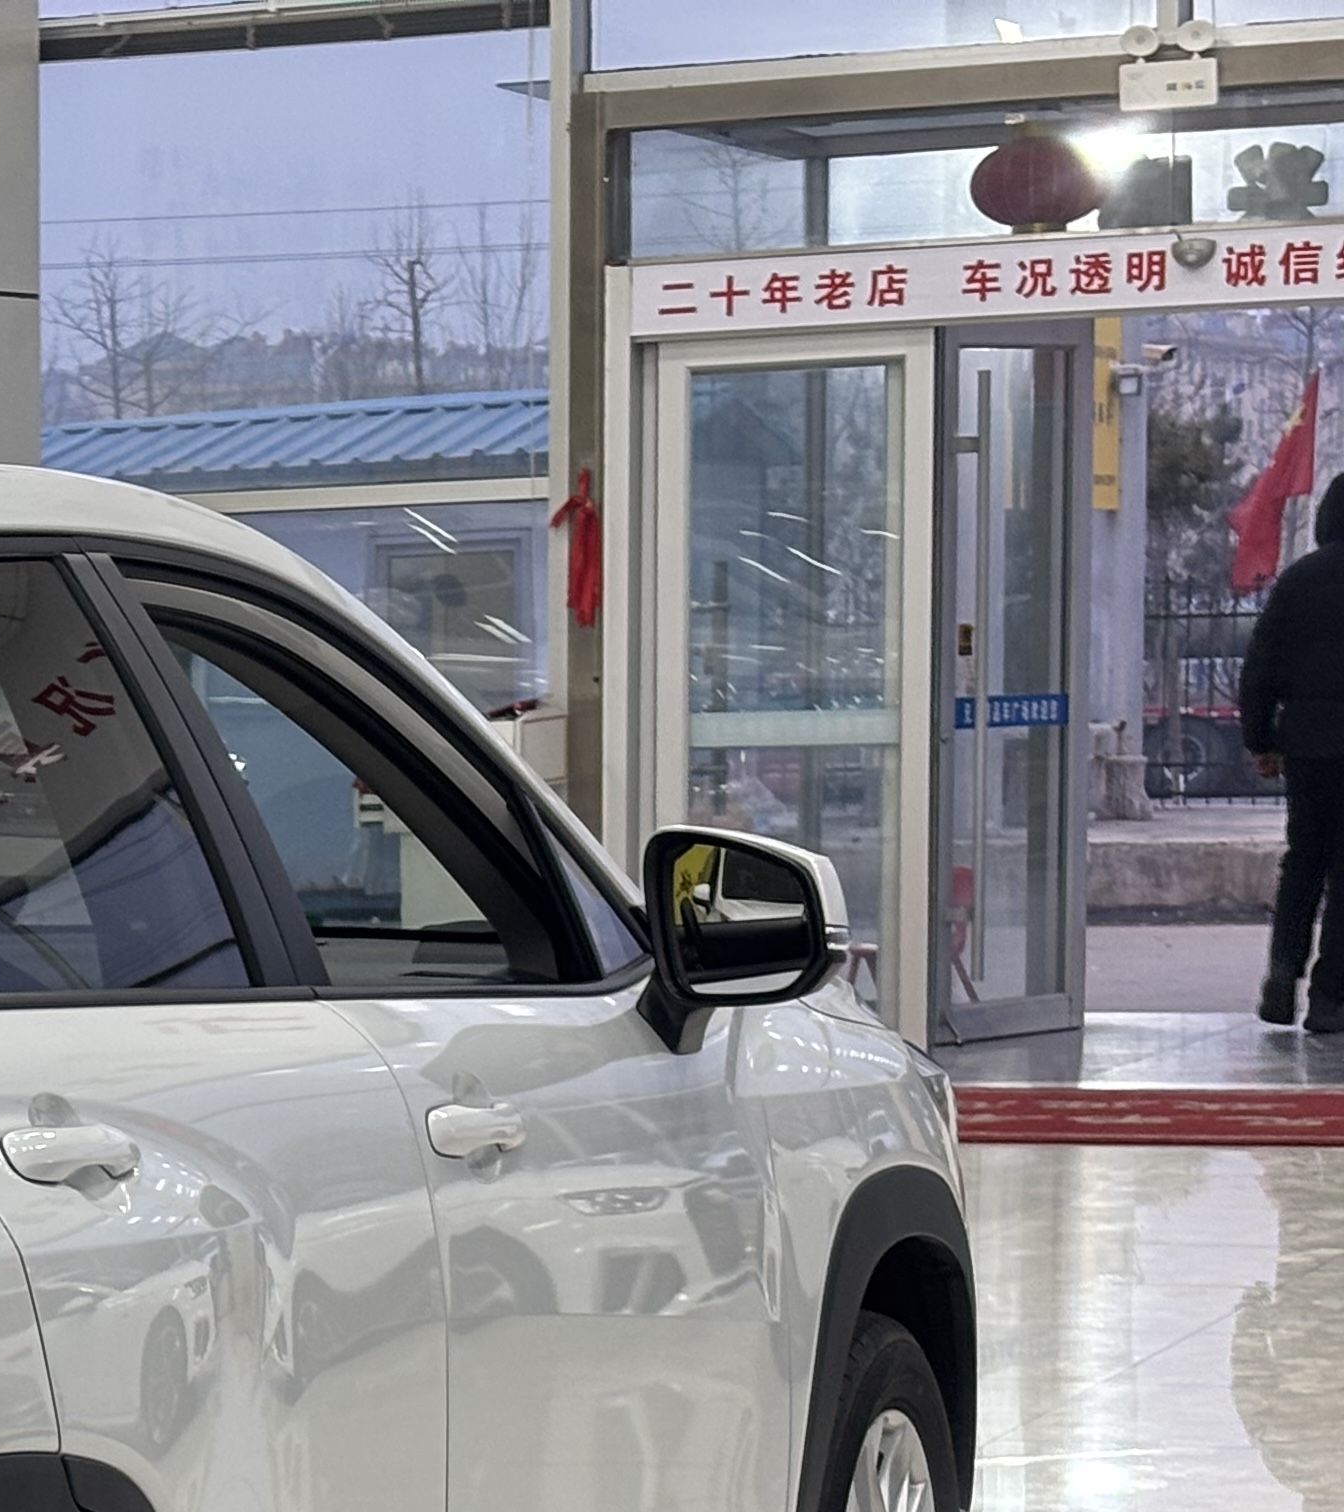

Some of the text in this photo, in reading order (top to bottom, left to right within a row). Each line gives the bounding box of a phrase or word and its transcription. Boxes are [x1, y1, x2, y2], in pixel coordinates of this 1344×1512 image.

[657, 240, 1344, 317] 二十年老店 车况透明 诚信
